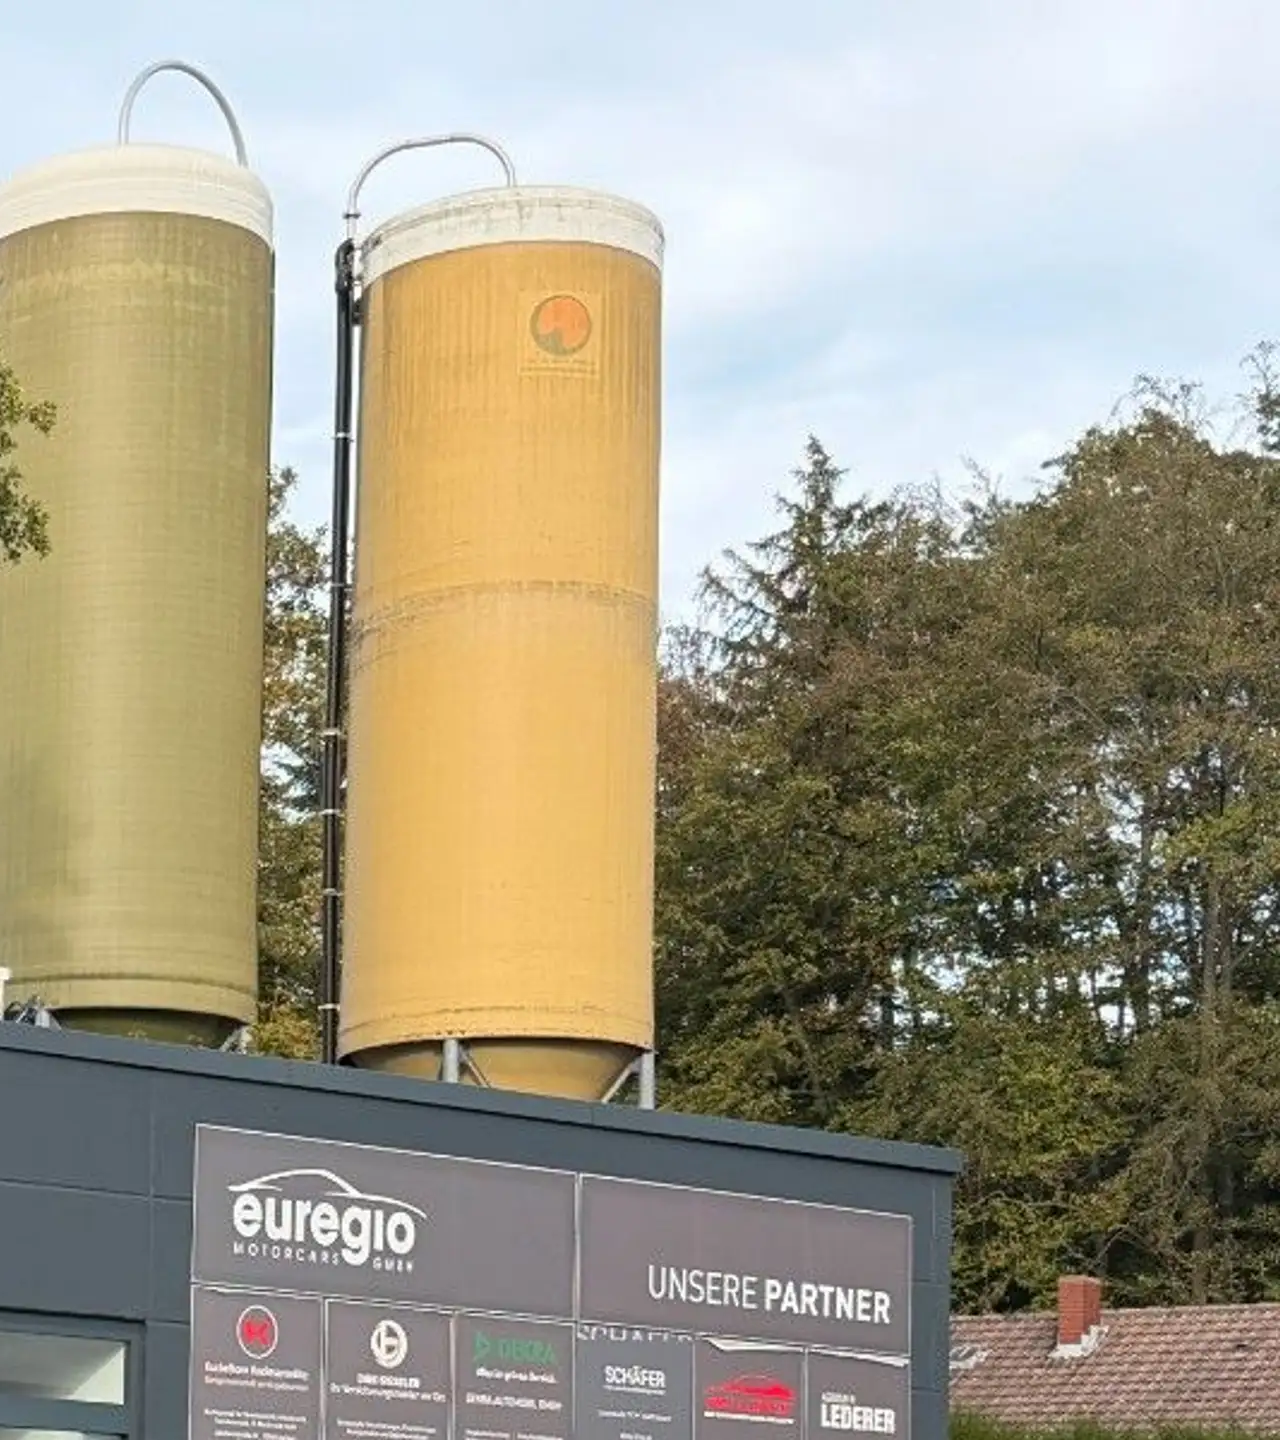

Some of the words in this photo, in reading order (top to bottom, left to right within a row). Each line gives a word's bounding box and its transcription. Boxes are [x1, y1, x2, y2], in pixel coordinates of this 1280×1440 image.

[232, 1193, 416, 1266] euregio
[233, 1241, 340, 1266] MOTORCARS
[647, 1264, 758, 1310] UNSERE
[763, 1277, 892, 1324] PARTNER
[820, 1403, 895, 1433] LEDERER
